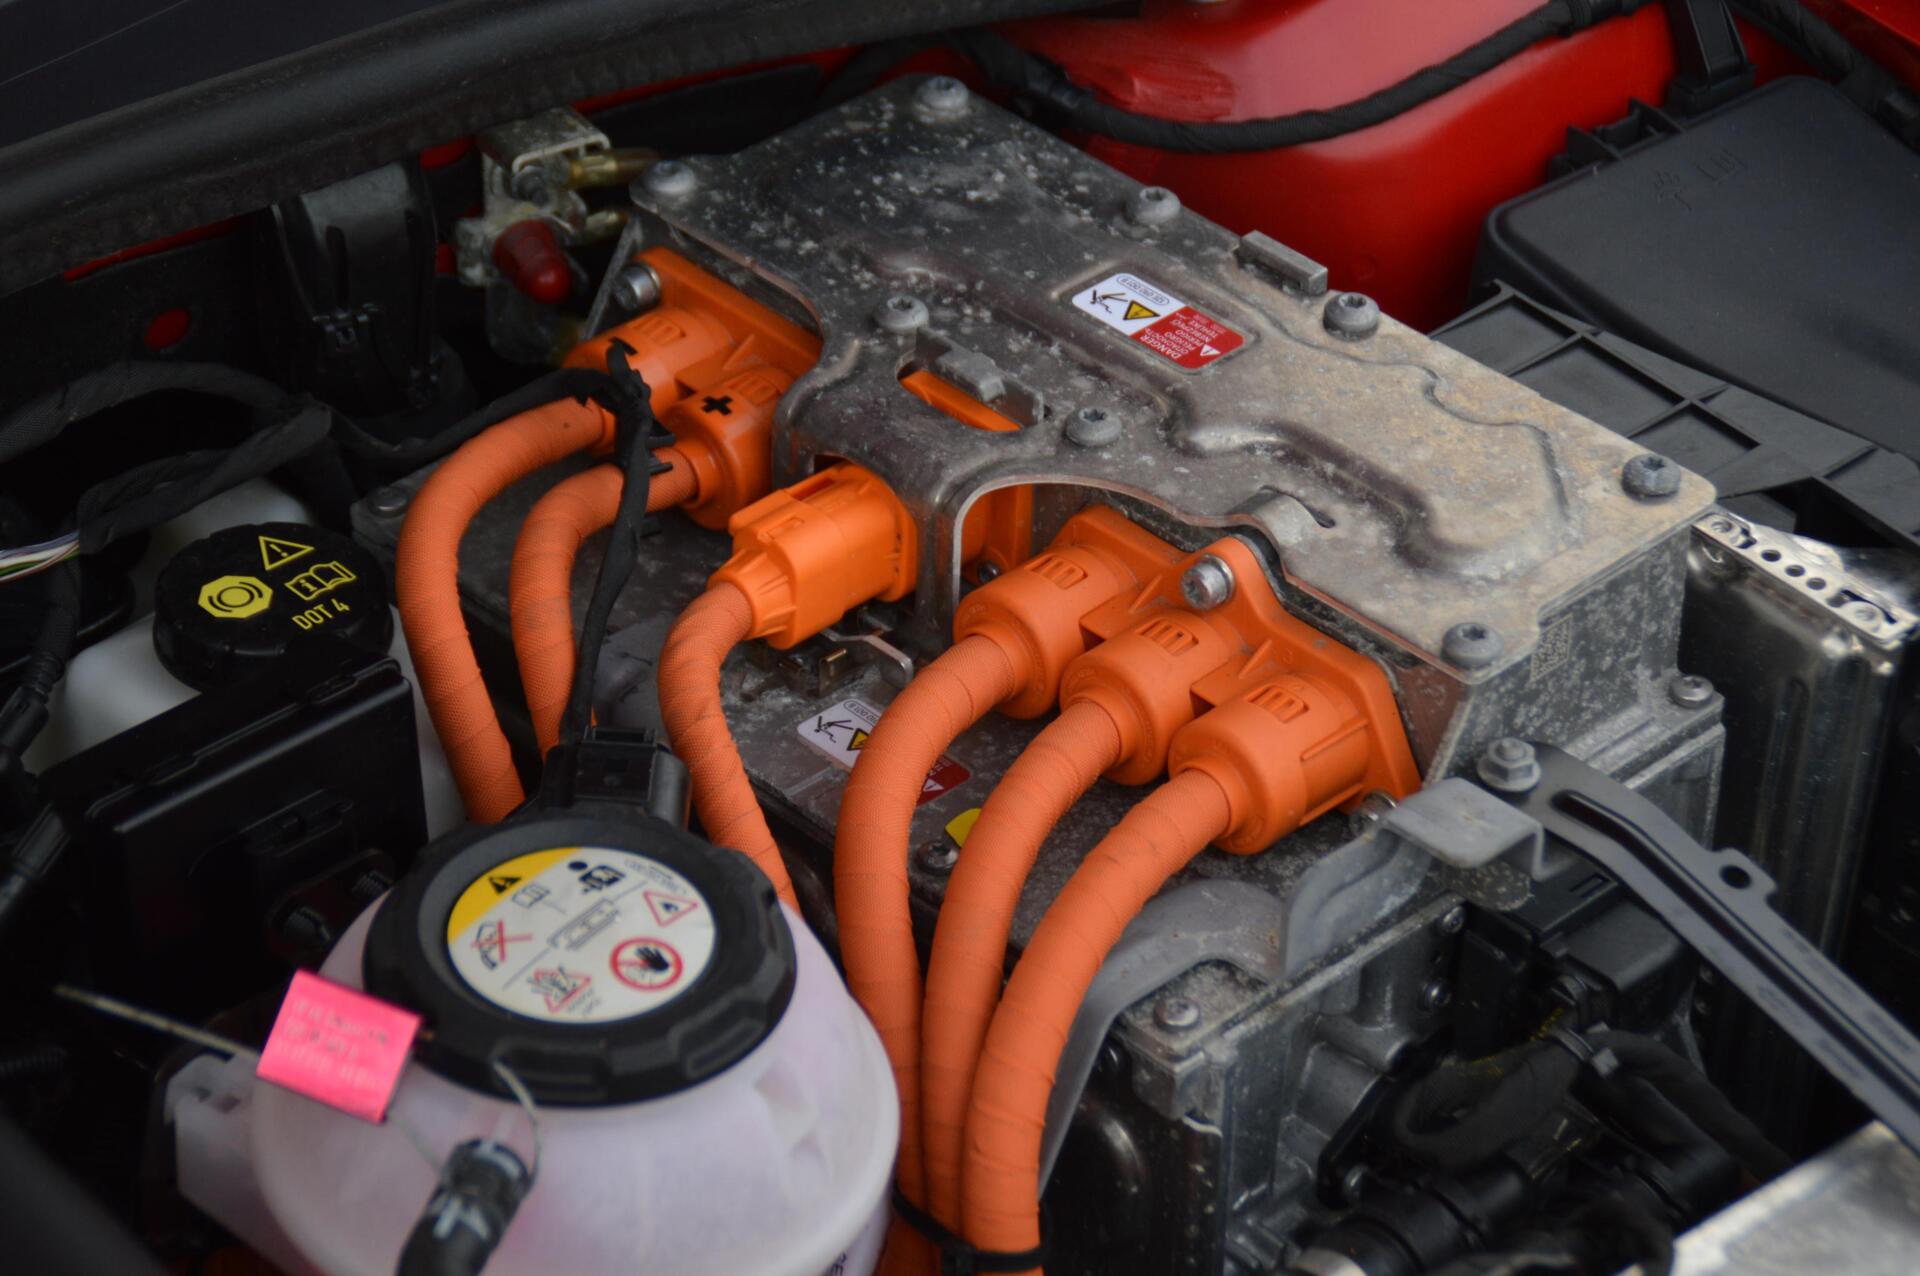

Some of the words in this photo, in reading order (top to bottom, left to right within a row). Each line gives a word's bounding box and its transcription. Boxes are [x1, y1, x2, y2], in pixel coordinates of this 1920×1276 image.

[1139, 334, 1181, 360] DANGER
[1164, 331, 1197, 351] PELIGRO
[1174, 329, 1204, 347] PERIGO
[292, 604, 333, 630] DOT
[331, 598, 350, 611] 4
